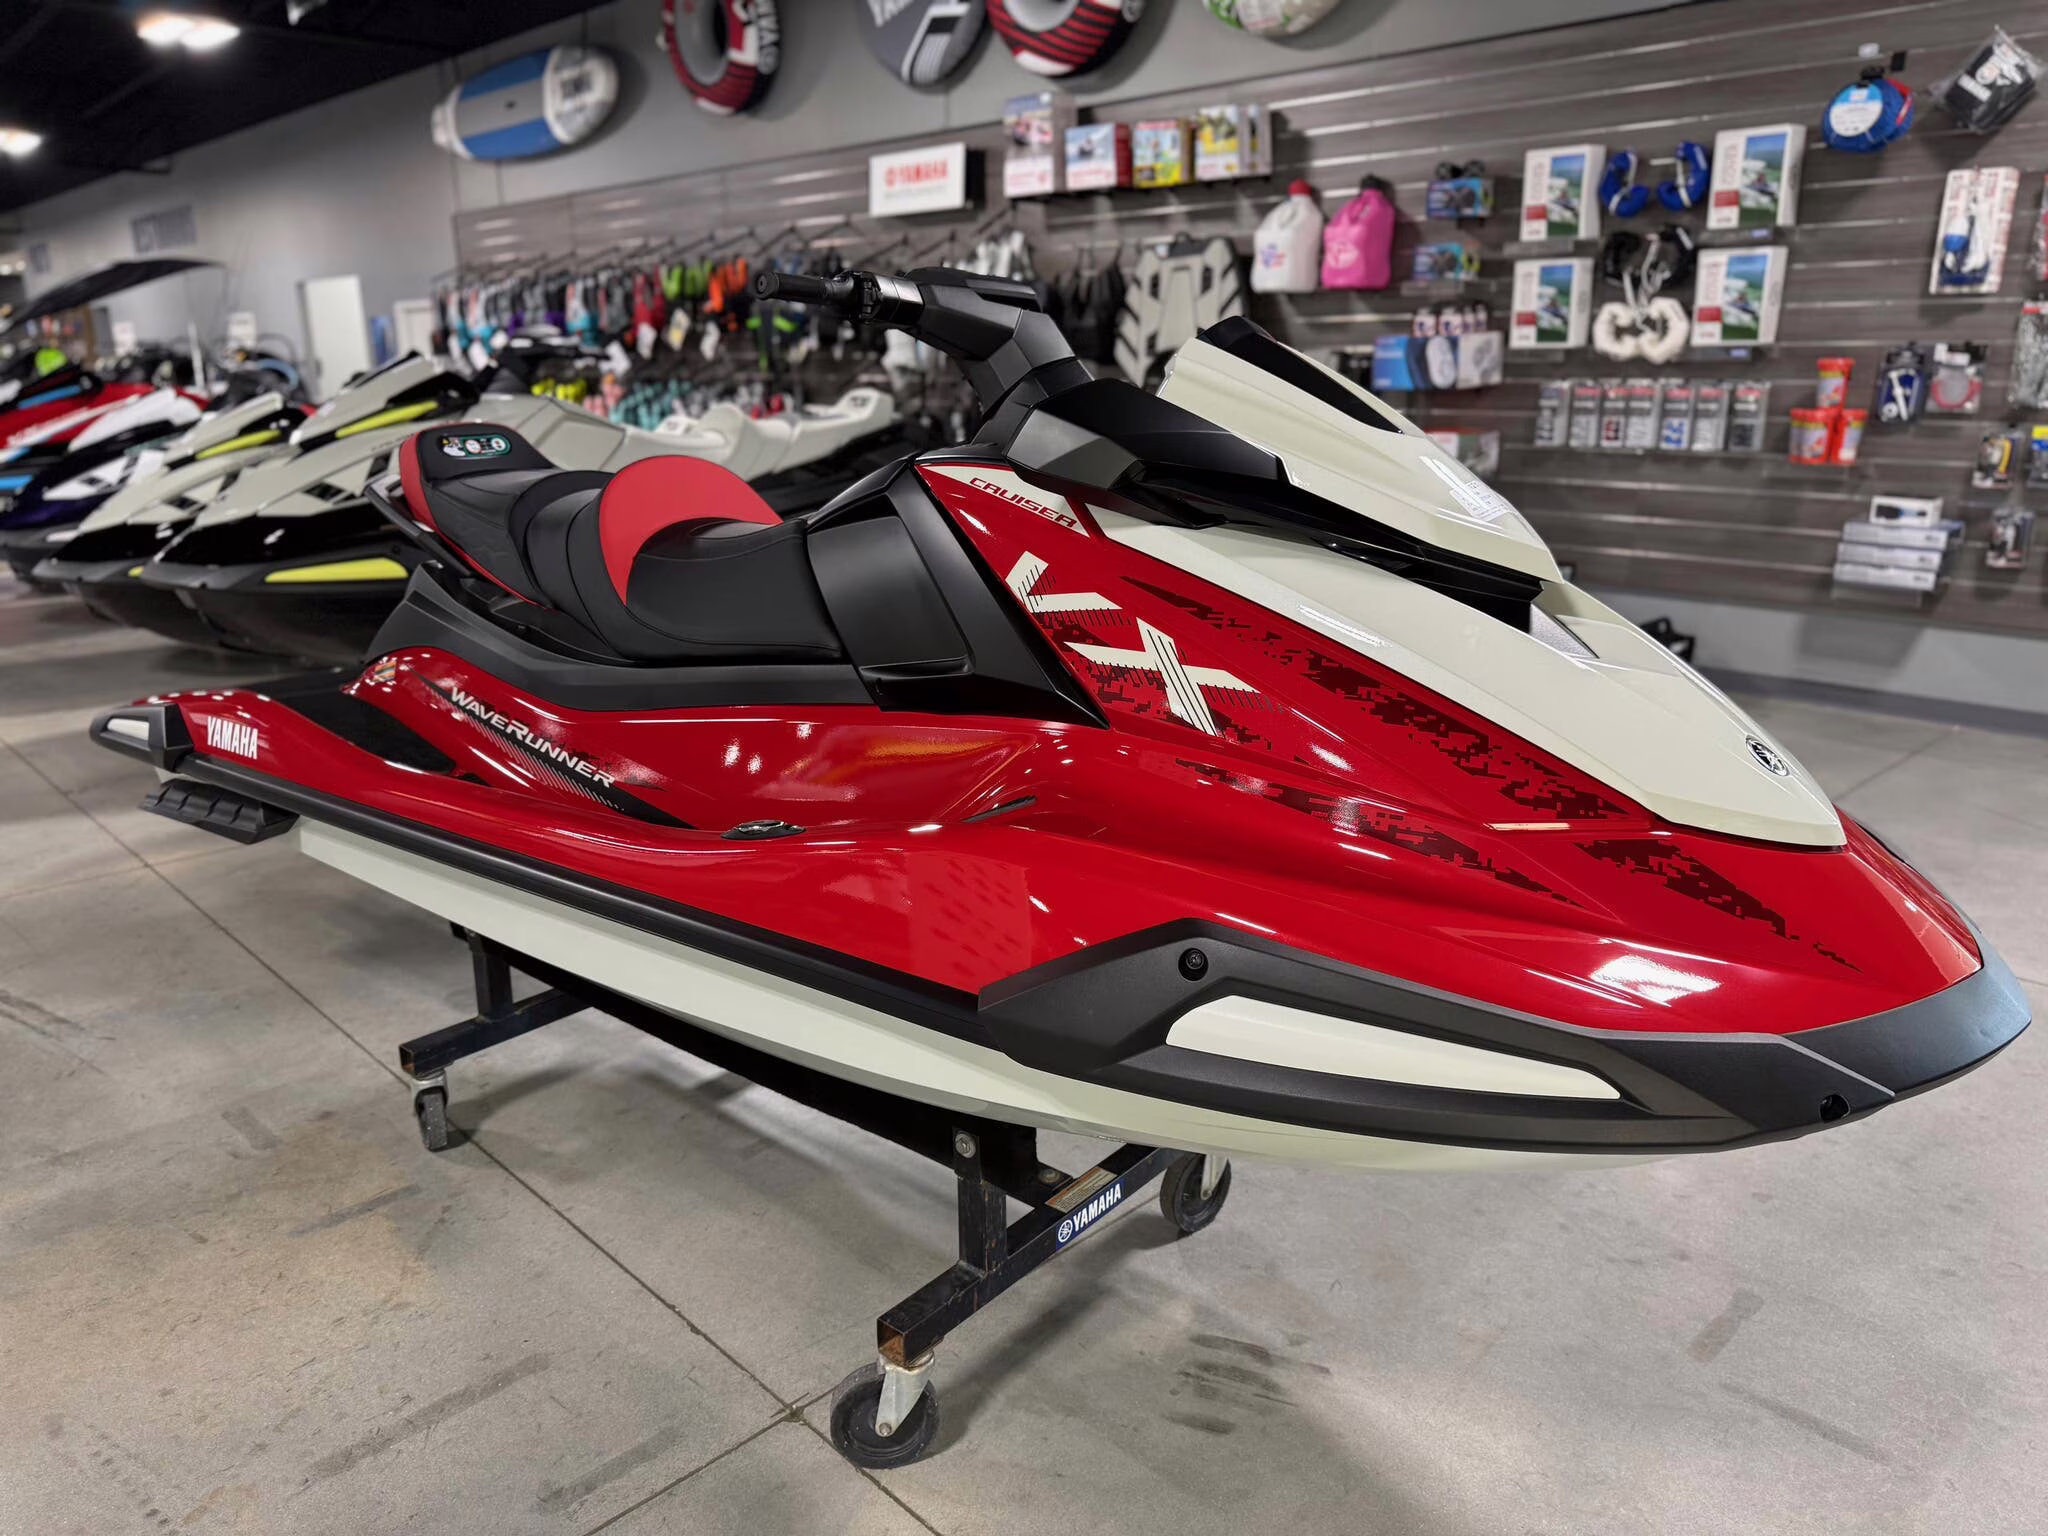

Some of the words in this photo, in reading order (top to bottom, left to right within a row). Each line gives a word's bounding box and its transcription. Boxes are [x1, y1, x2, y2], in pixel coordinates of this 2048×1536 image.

[969, 477, 1078, 528] CRUISER
[1005, 550, 1262, 737] VX
[207, 715, 259, 760] YAMAHA
[1073, 1183, 1121, 1232] YAMAHA
